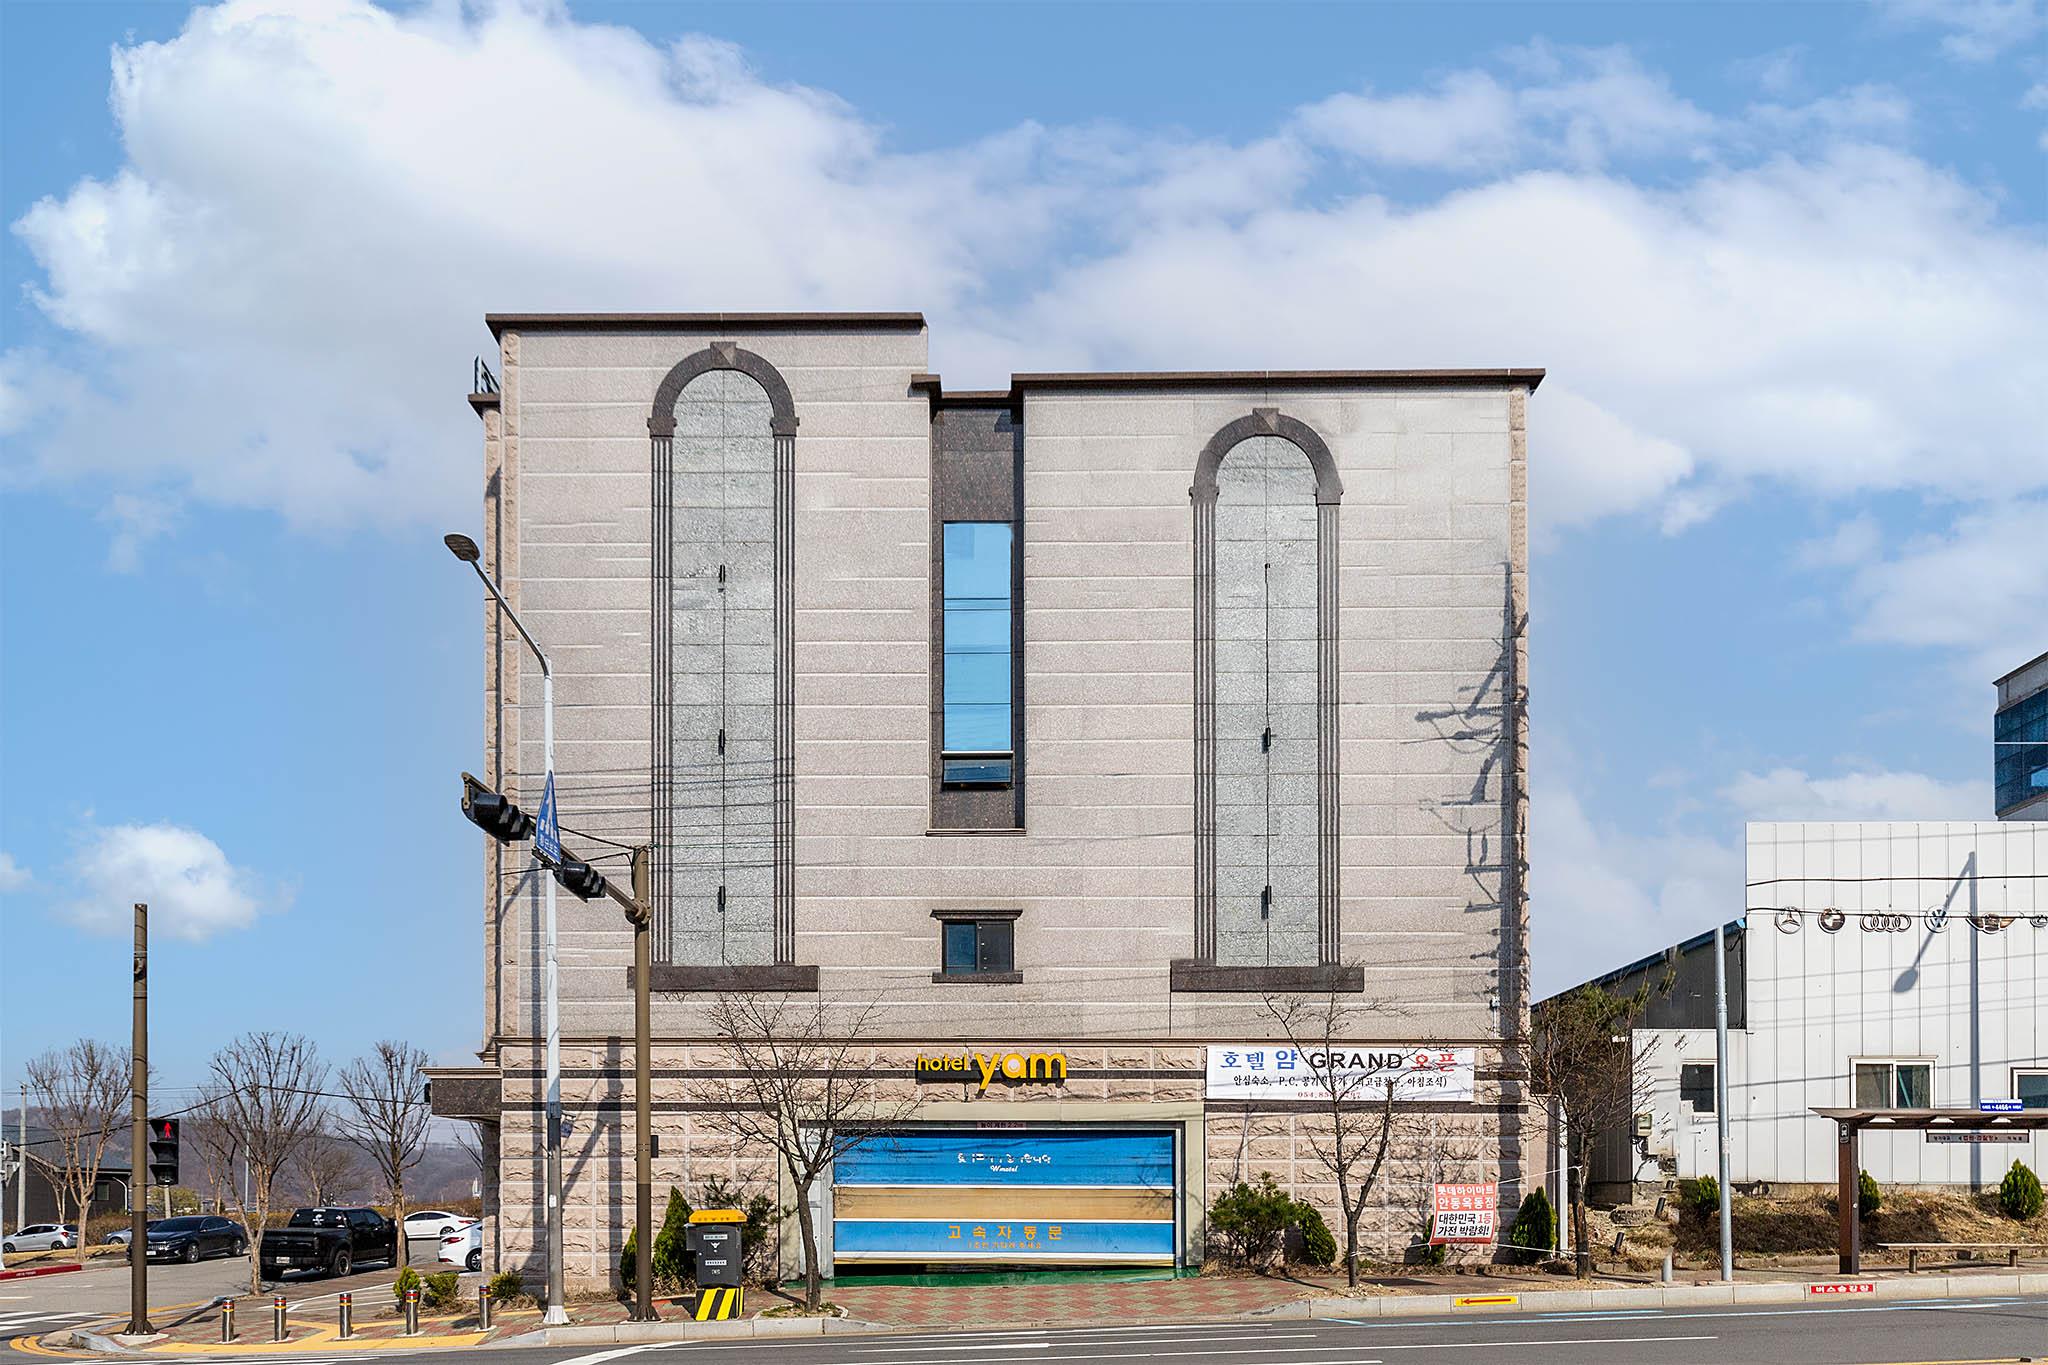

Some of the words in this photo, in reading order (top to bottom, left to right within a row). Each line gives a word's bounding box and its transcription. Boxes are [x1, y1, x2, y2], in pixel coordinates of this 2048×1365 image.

[1220, 1051, 1264, 1070] 호텔
[1275, 1049, 1298, 1070] 얌
[1310, 1052, 1402, 1069] GRAND
[1410, 1053, 1457, 1072] 오픈
[917, 1053, 968, 1071] hotel
[974, 1053, 1067, 1091] yam
[1437, 1185, 1494, 1196] 롯데하이마트
[1439, 1213, 1476, 1225] 대한민국
[1477, 1212, 1492, 1224] 1등
[1437, 1226, 1458, 1236] 가전
[1459, 1225, 1490, 1236] 박람회!
